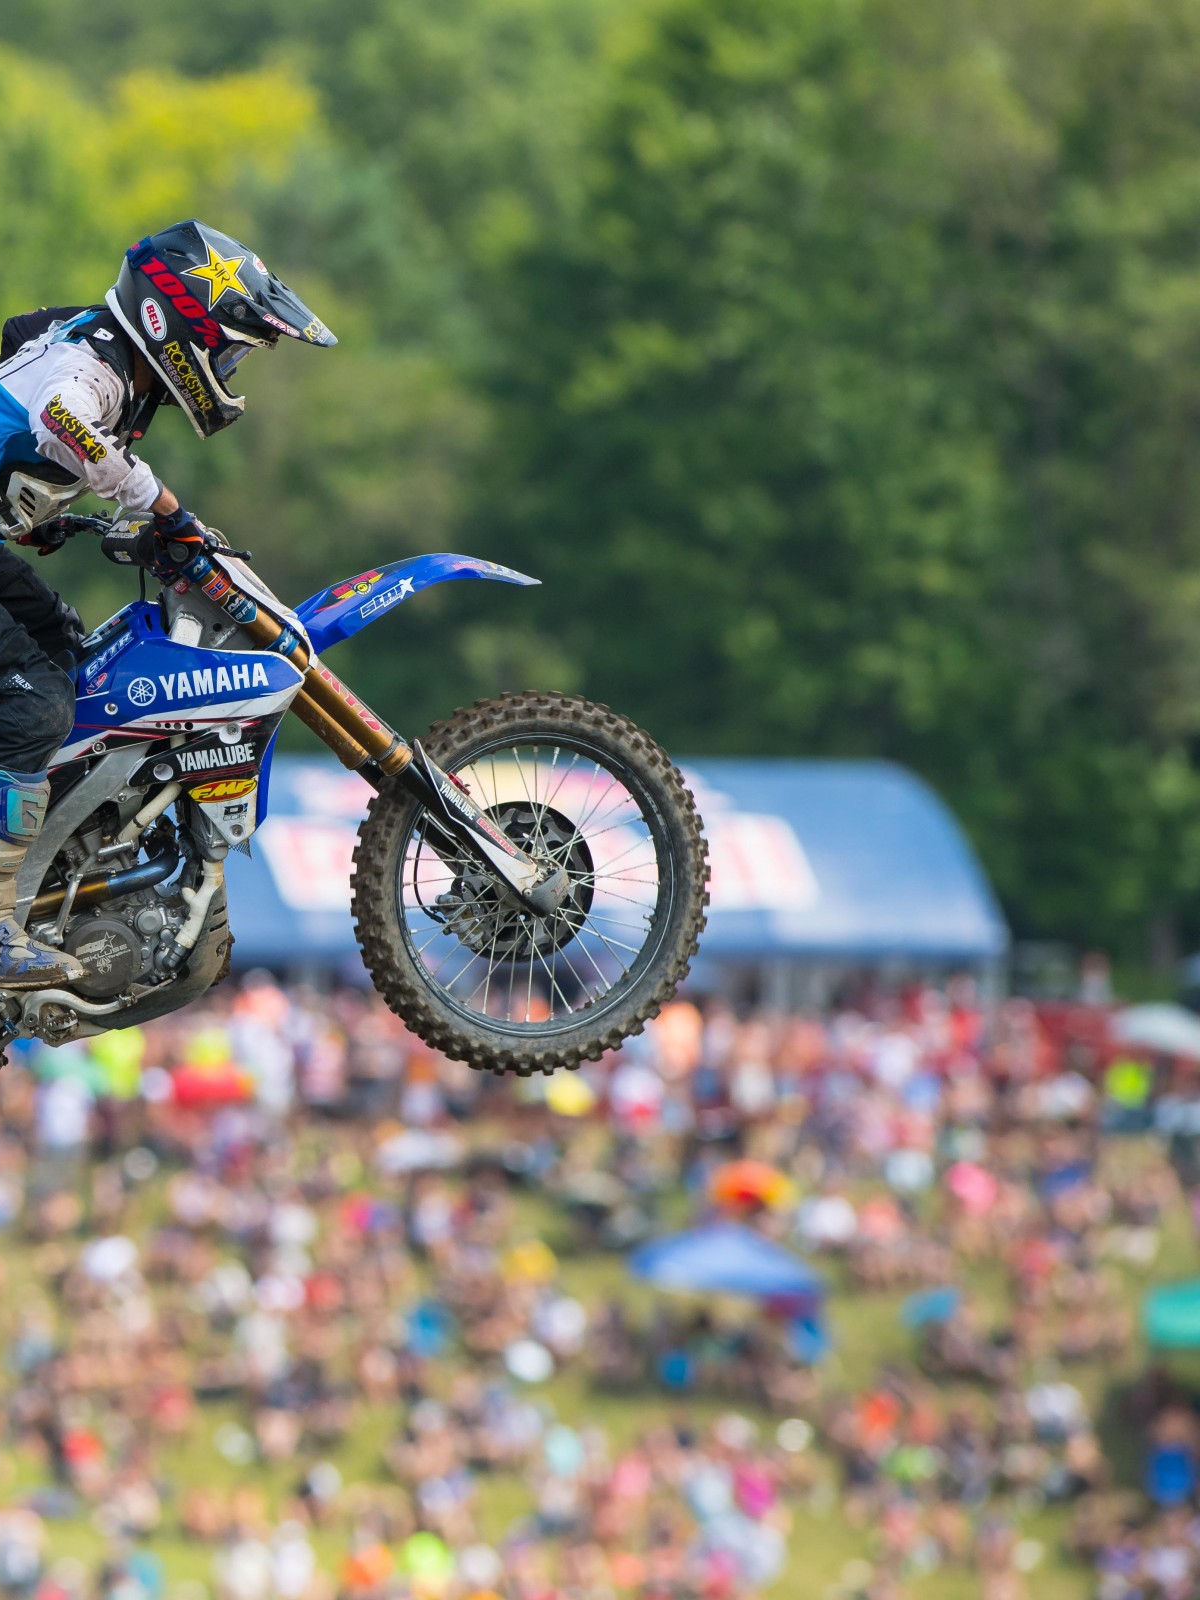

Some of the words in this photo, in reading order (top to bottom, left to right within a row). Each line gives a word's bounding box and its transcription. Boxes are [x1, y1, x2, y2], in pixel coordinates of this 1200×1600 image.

[140, 257, 222, 347] 100%
[146, 304, 162, 335] BELL
[159, 354, 184, 387] ENERGY
[181, 389, 200, 412] DRINK
[85, 630, 133, 679] GYTR
[12, 674, 33, 690] PULSE
[159, 662, 269, 700] YAMAHA
[176, 743, 256, 773] YAMALUBE
[190, 779, 256, 800] FMF
[438, 781, 477, 821] YAMALUBE
[475, 816, 517, 857] BRAKING
[81, 944, 128, 964] EKLUSE
